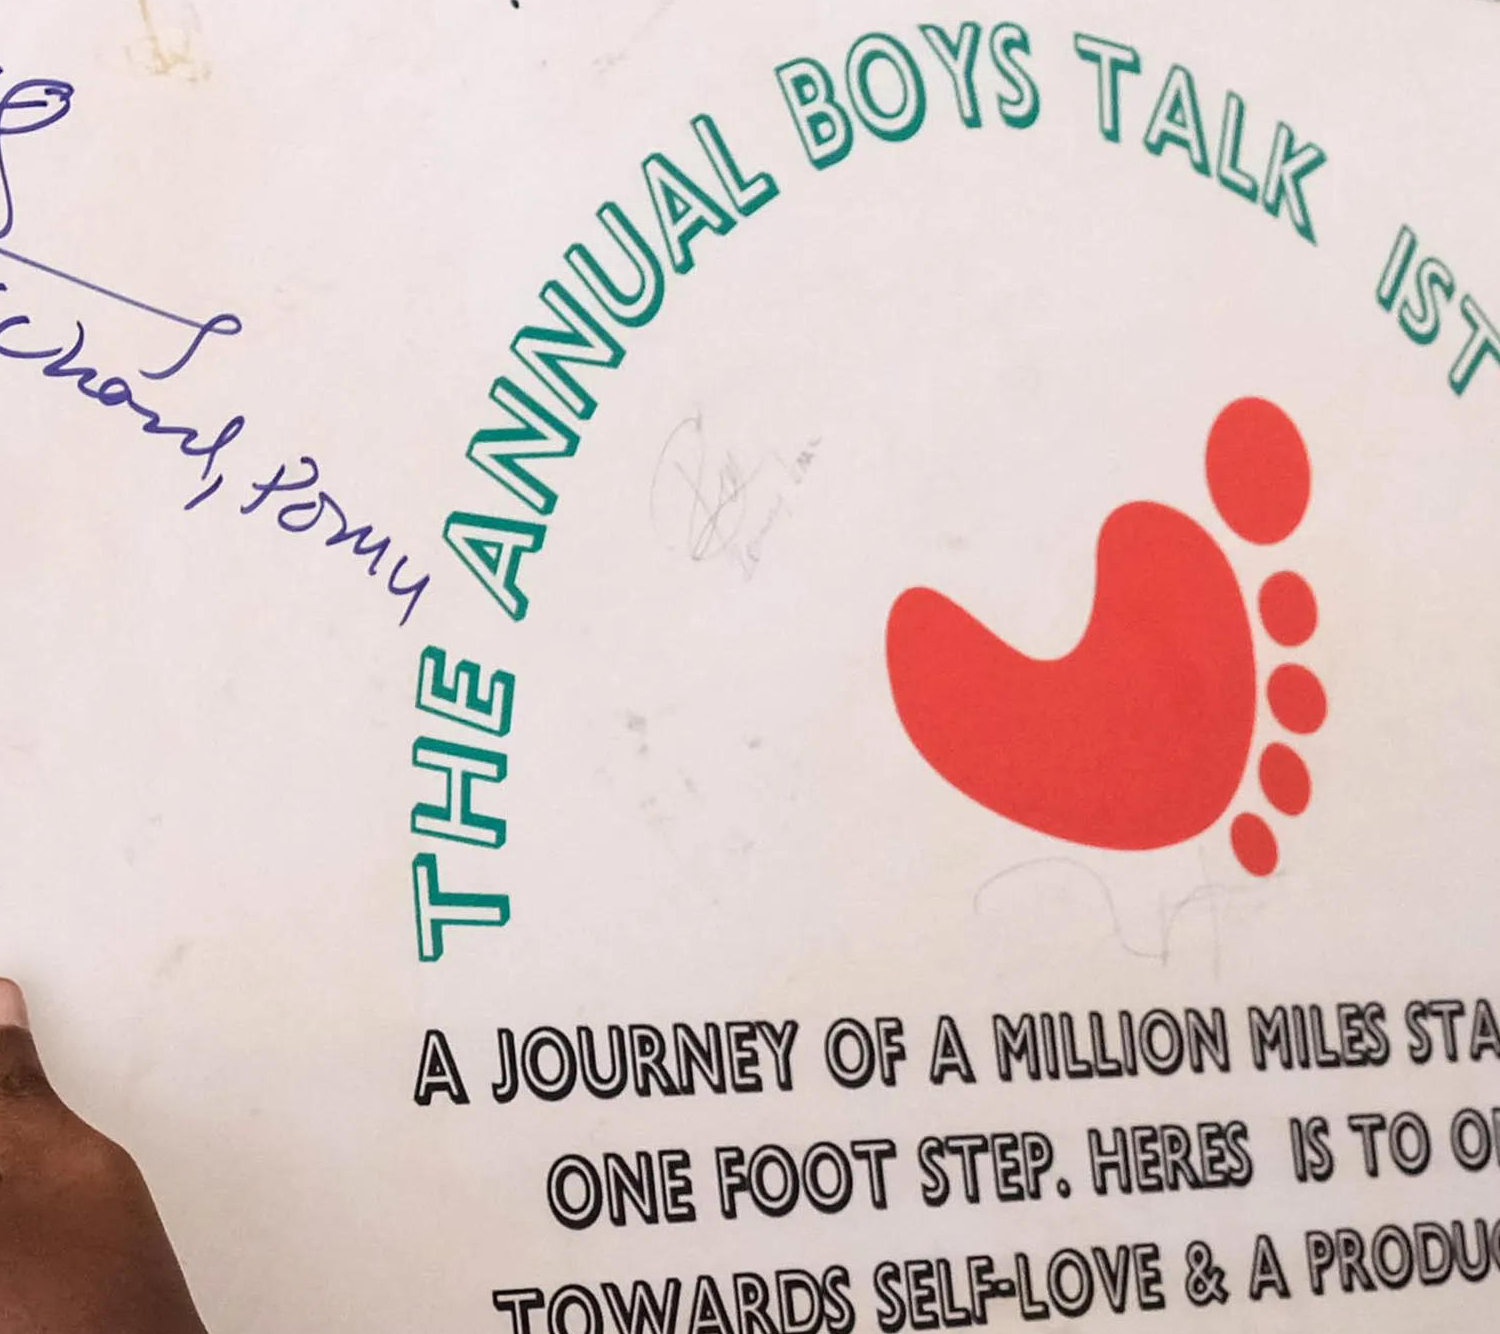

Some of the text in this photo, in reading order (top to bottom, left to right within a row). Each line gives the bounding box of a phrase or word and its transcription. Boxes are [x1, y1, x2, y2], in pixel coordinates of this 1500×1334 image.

[776, 22, 1041, 171] BOYS
[1074, 32, 1328, 245] TALK
[442, 114, 780, 622] ANNUAL
[411, 645, 515, 963] THE
[414, 1029, 469, 1105] A
[492, 1020, 798, 1104] JOURNEY
[824, 1017, 906, 1088] OF
[929, 1014, 976, 1085] A
[993, 1006, 1230, 1082] MILLION
[1248, 1002, 1391, 1071] MILES
[547, 1149, 695, 1230] ONE
[716, 1139, 896, 1217] FOOT
[918, 1131, 1071, 1207] STEP.
[1088, 1120, 1253, 1196] HERES
[1290, 1115, 1334, 1182] IS
[1349, 1108, 1432, 1178] TO
[873, 1242, 1166, 1334] SELF-LOVE
[1185, 1239, 1229, 1306] &
[1249, 1233, 1291, 1302] A
